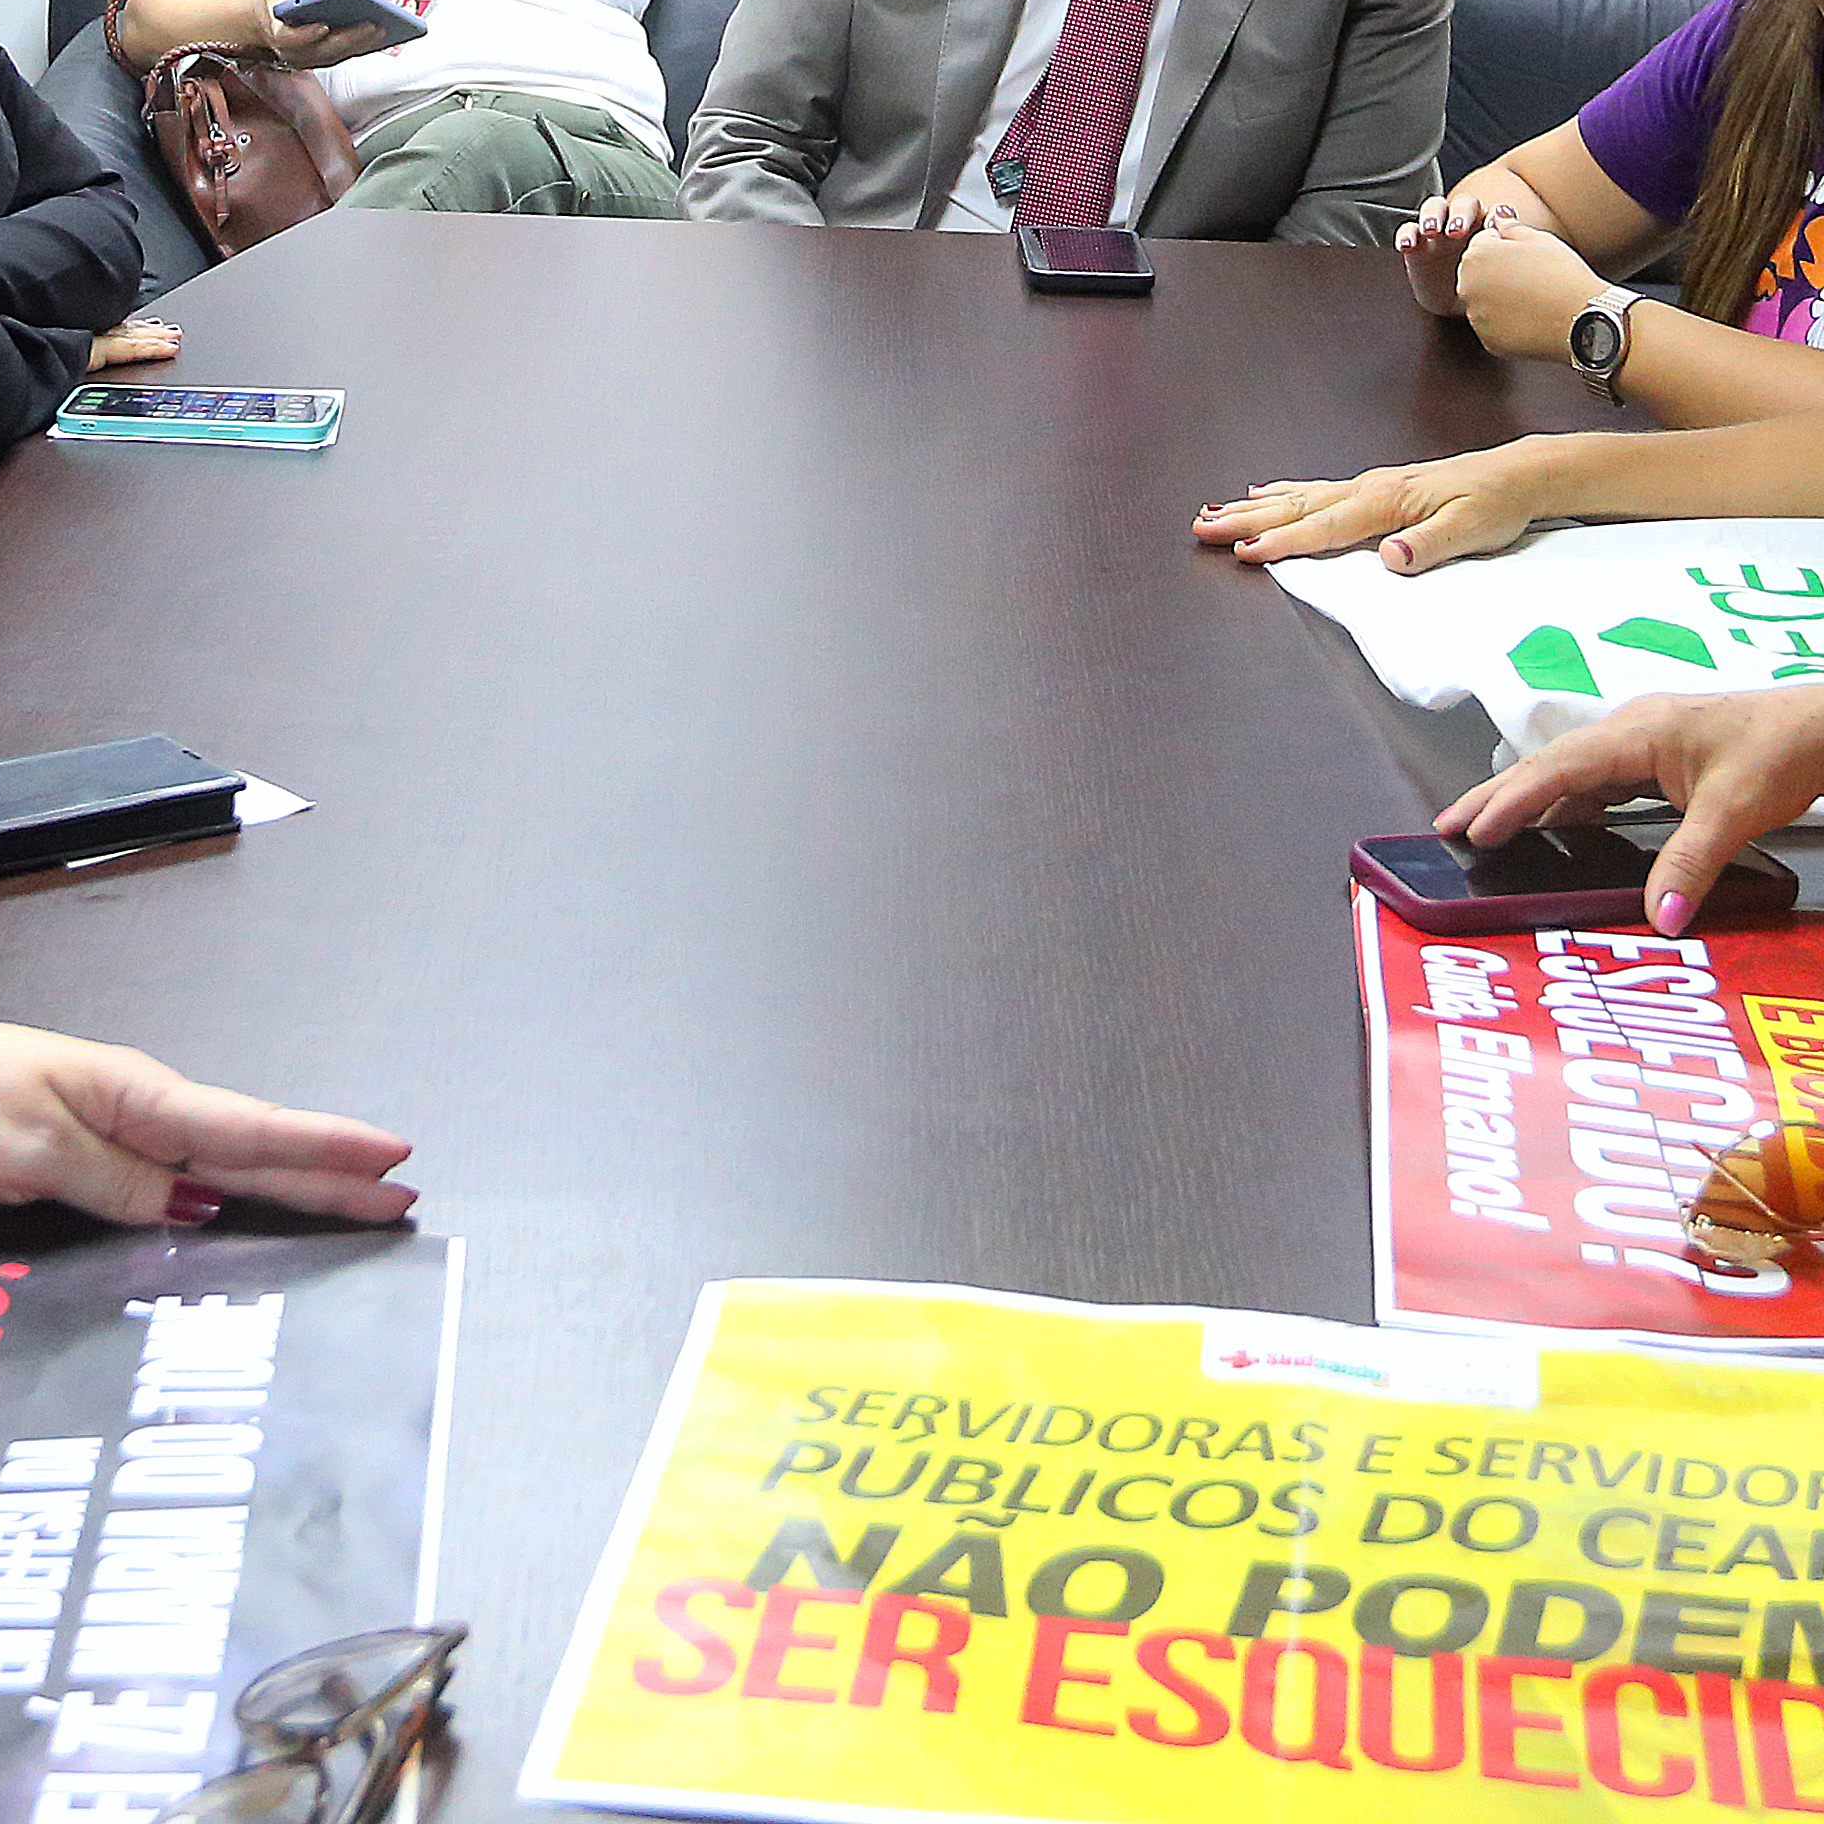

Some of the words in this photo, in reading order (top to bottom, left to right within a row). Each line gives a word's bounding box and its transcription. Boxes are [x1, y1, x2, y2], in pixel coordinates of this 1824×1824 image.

[1410, 943, 1521, 1021] Cuida,
[1435, 1021, 1552, 1235] Elmano!
[1533, 926, 1794, 1298] ESQUECIDO?
[109, 1422, 265, 1502] DO
[796, 1384, 1331, 1465] SERVIDORAS
[1353, 1433, 1404, 1475] E
[758, 1432, 1328, 1539] PÚBLICOS
[1359, 1492, 1540, 1552] DO
[67, 1503, 251, 1682] MARIA
[743, 1509, 1166, 1623] NÃO
[632, 1575, 973, 1715] SER
[22, 1690, 219, 1760] ZÉ
